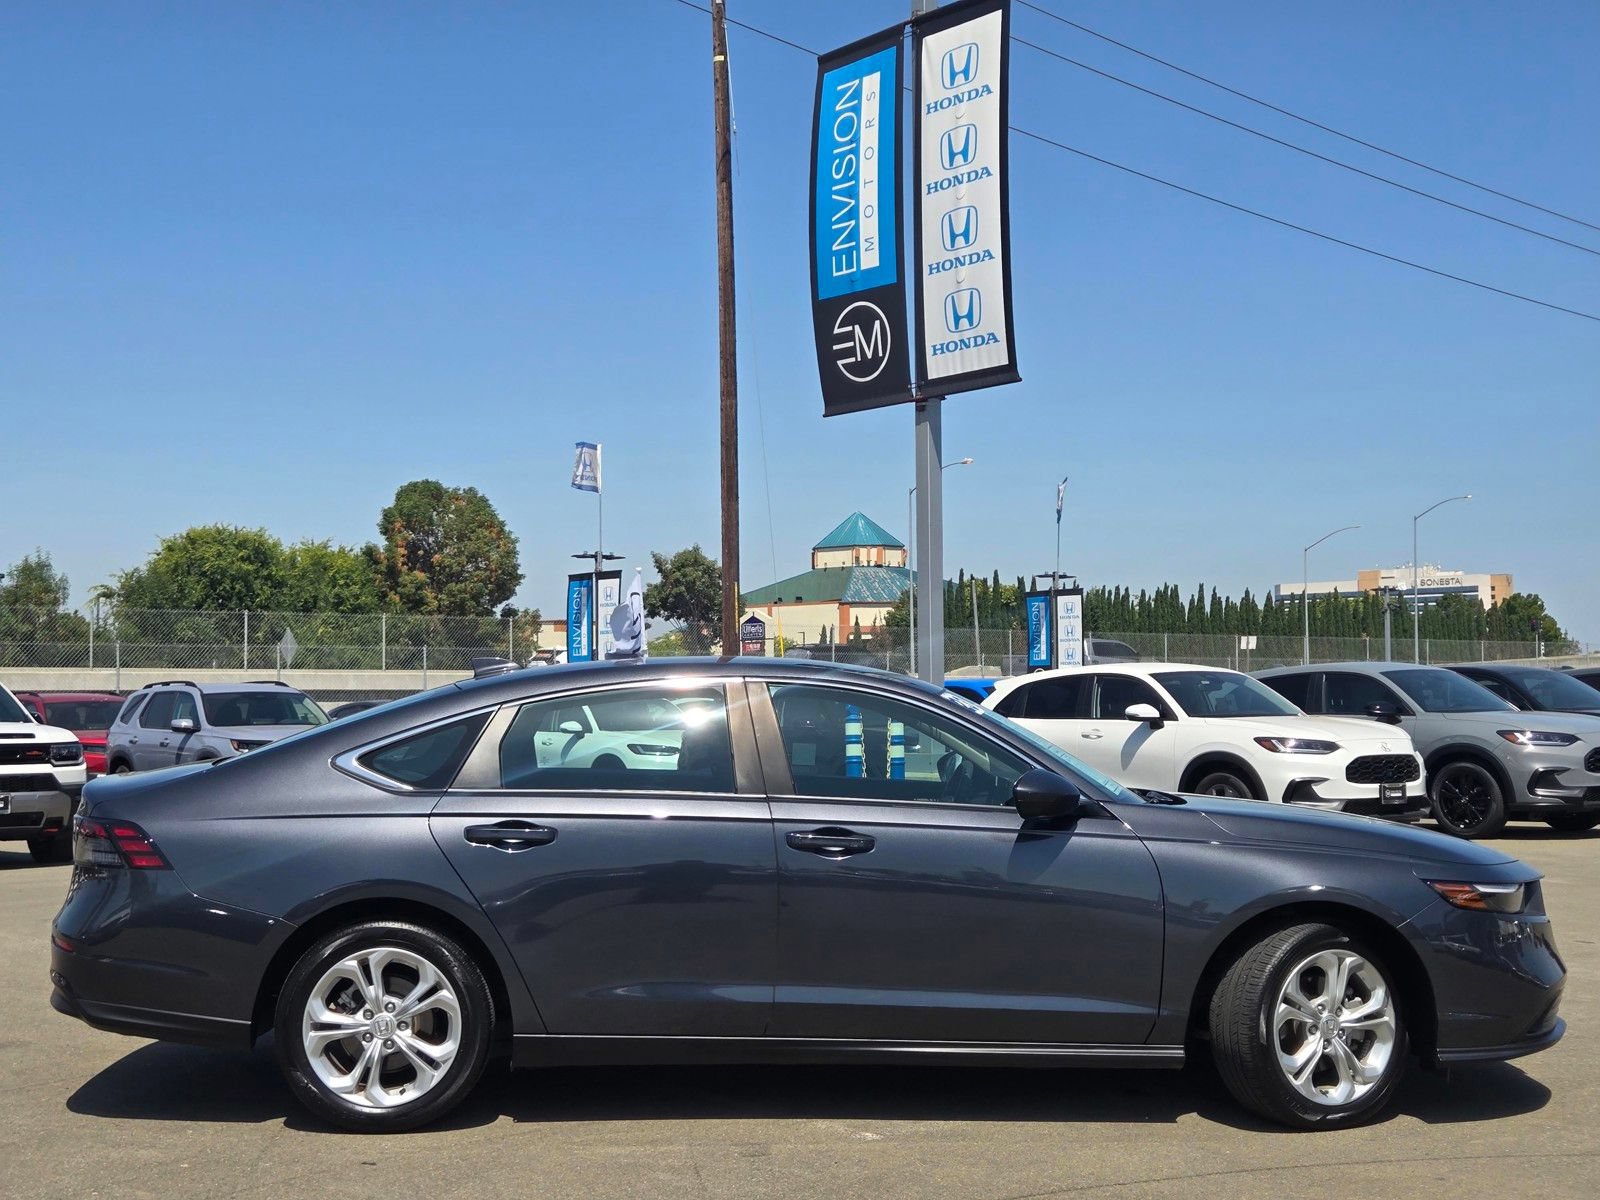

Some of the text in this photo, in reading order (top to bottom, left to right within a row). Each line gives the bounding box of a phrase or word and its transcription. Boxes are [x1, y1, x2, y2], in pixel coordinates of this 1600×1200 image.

[926, 84, 993, 115] HONDA
[832, 79, 860, 277] ENVISION
[863, 91, 876, 252] MOTORS
[926, 166, 993, 195] HONDA
[928, 249, 995, 276] HONDA
[931, 332, 1000, 357] HONDA
[1420, 578, 1461, 586] SONESTA
[573, 587, 582, 656] ENVISION
[1032, 602, 1040, 660] ENVISION
